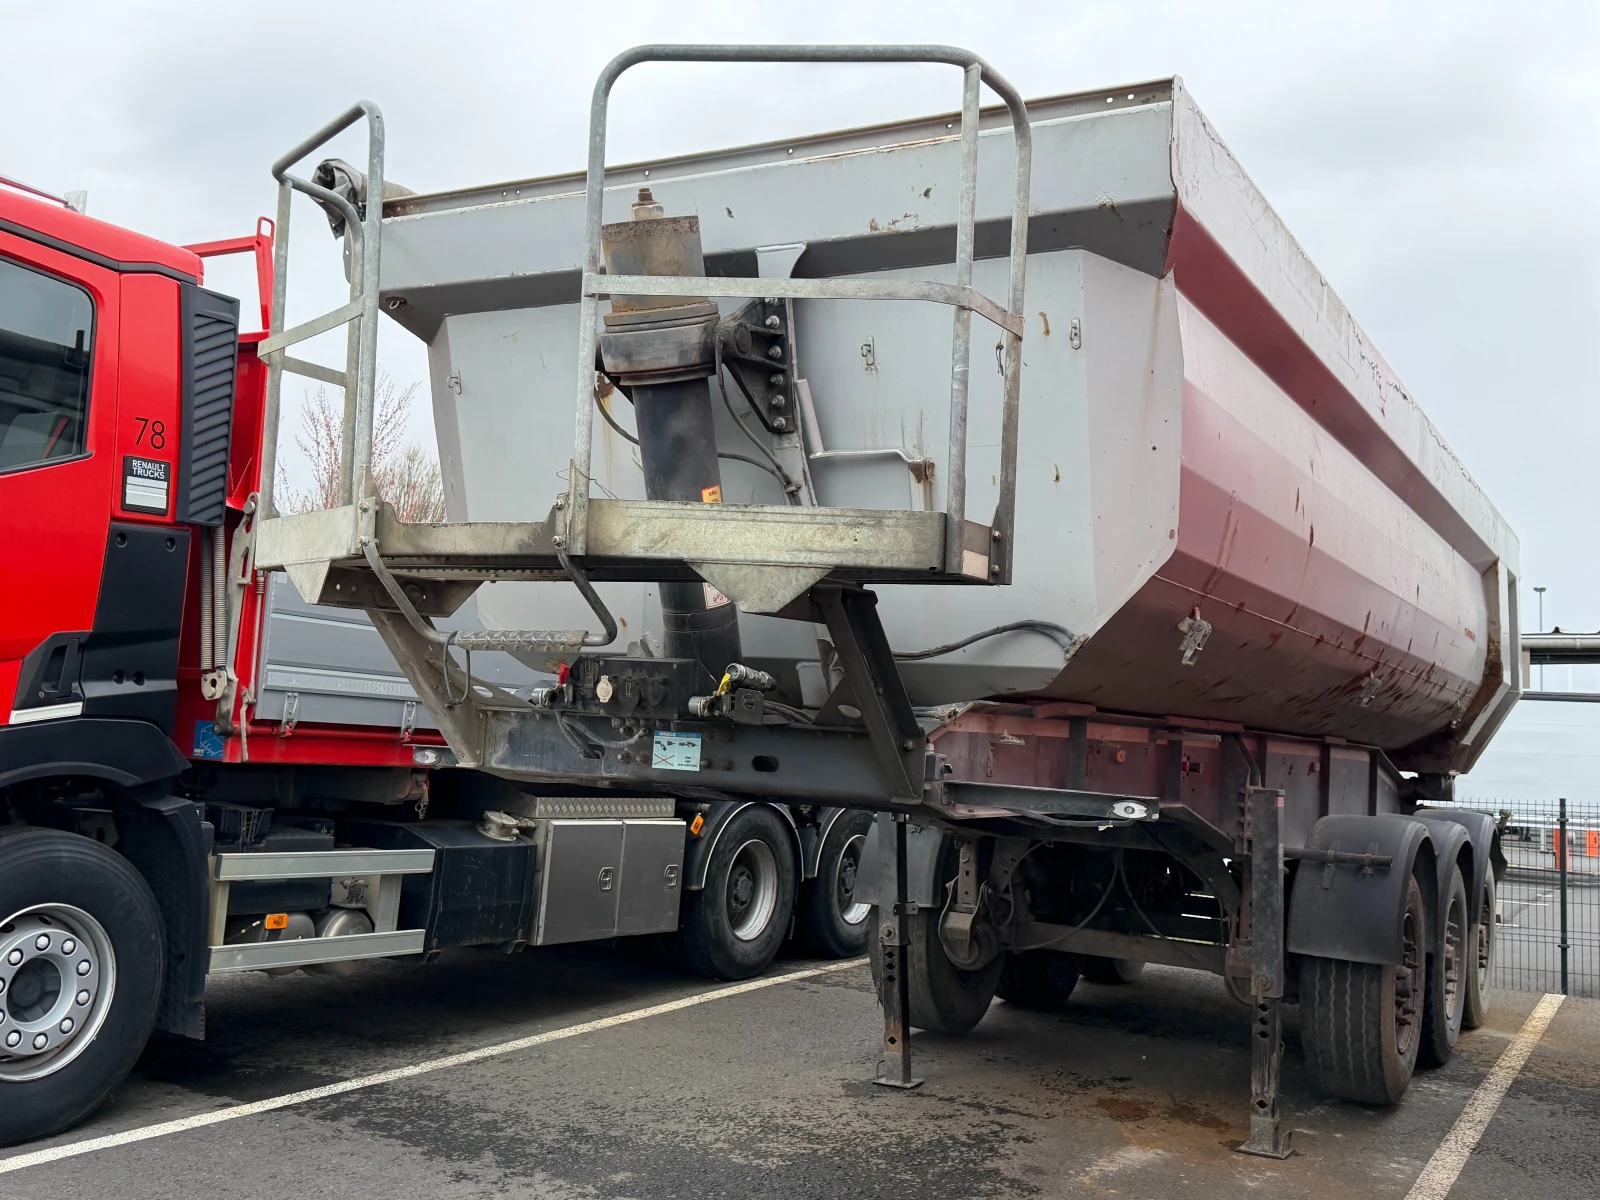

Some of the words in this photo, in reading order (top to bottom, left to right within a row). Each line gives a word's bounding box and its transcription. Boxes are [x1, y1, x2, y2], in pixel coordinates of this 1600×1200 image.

[135, 416, 165, 450] 78
[132, 460, 165, 471] RENAULT
[132, 468, 165, 479] TRUCKS
